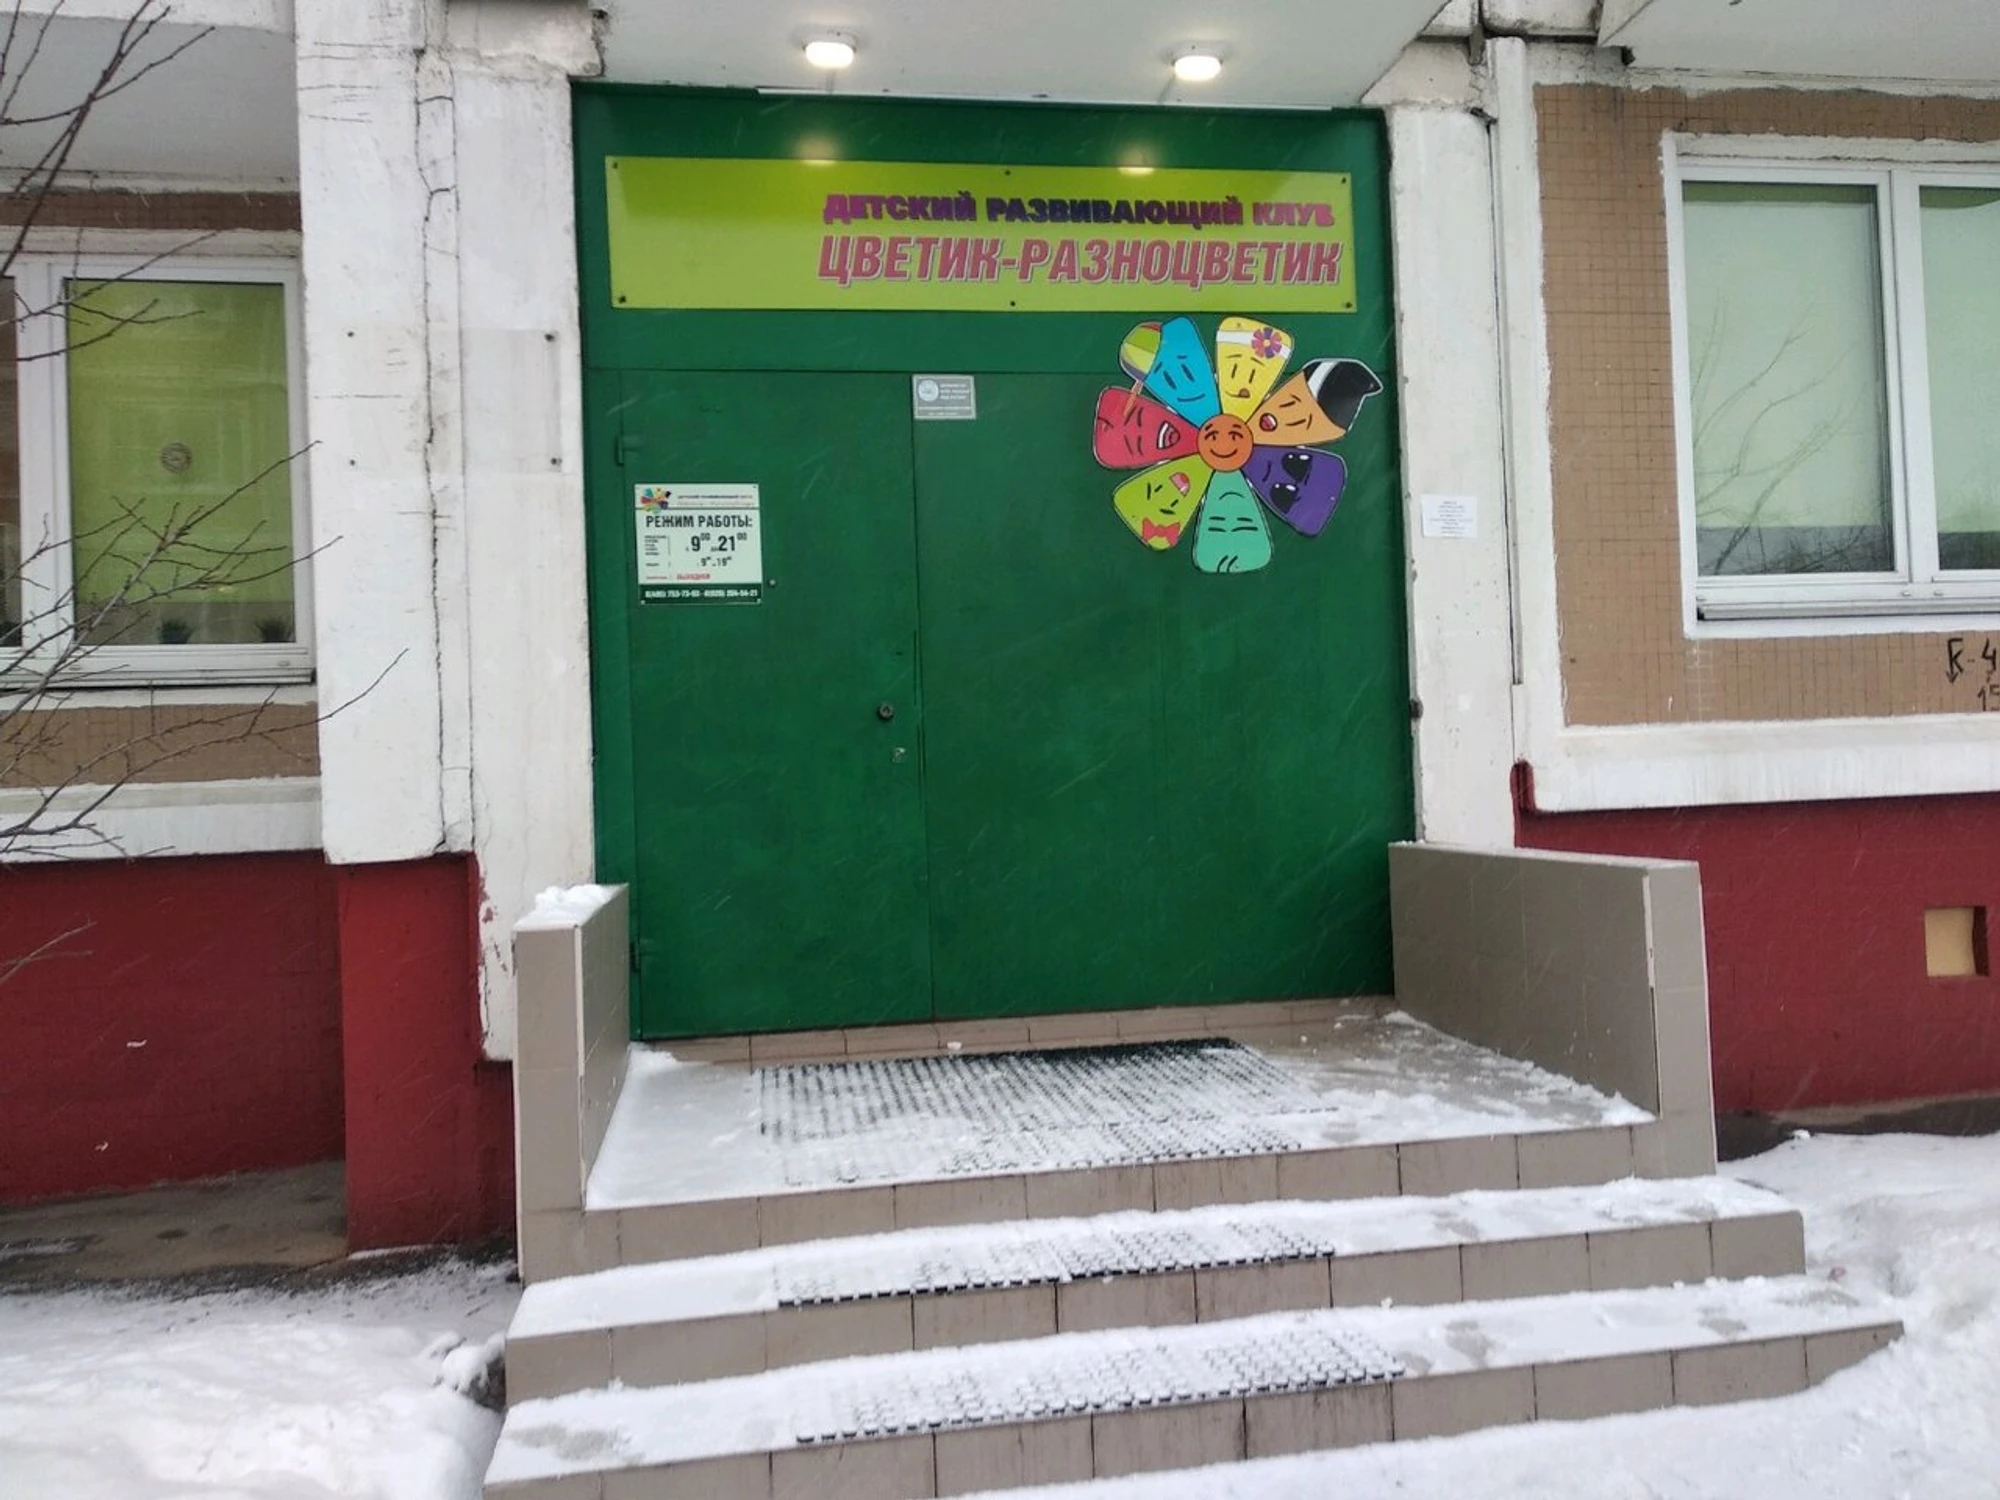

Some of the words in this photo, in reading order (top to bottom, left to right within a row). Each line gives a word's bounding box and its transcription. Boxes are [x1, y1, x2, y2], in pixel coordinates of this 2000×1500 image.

[823, 190, 977, 225] ДЕТСКИЙ
[985, 195, 1244, 230] РАЗВИВАЮЩИЙ
[818, 234, 1343, 291] ЦВЕТИК-РАЗНОЦВЕТИК
[645, 515, 695, 528] РЕЖИМ
[698, 515, 753, 528] РАБОТЫ:
